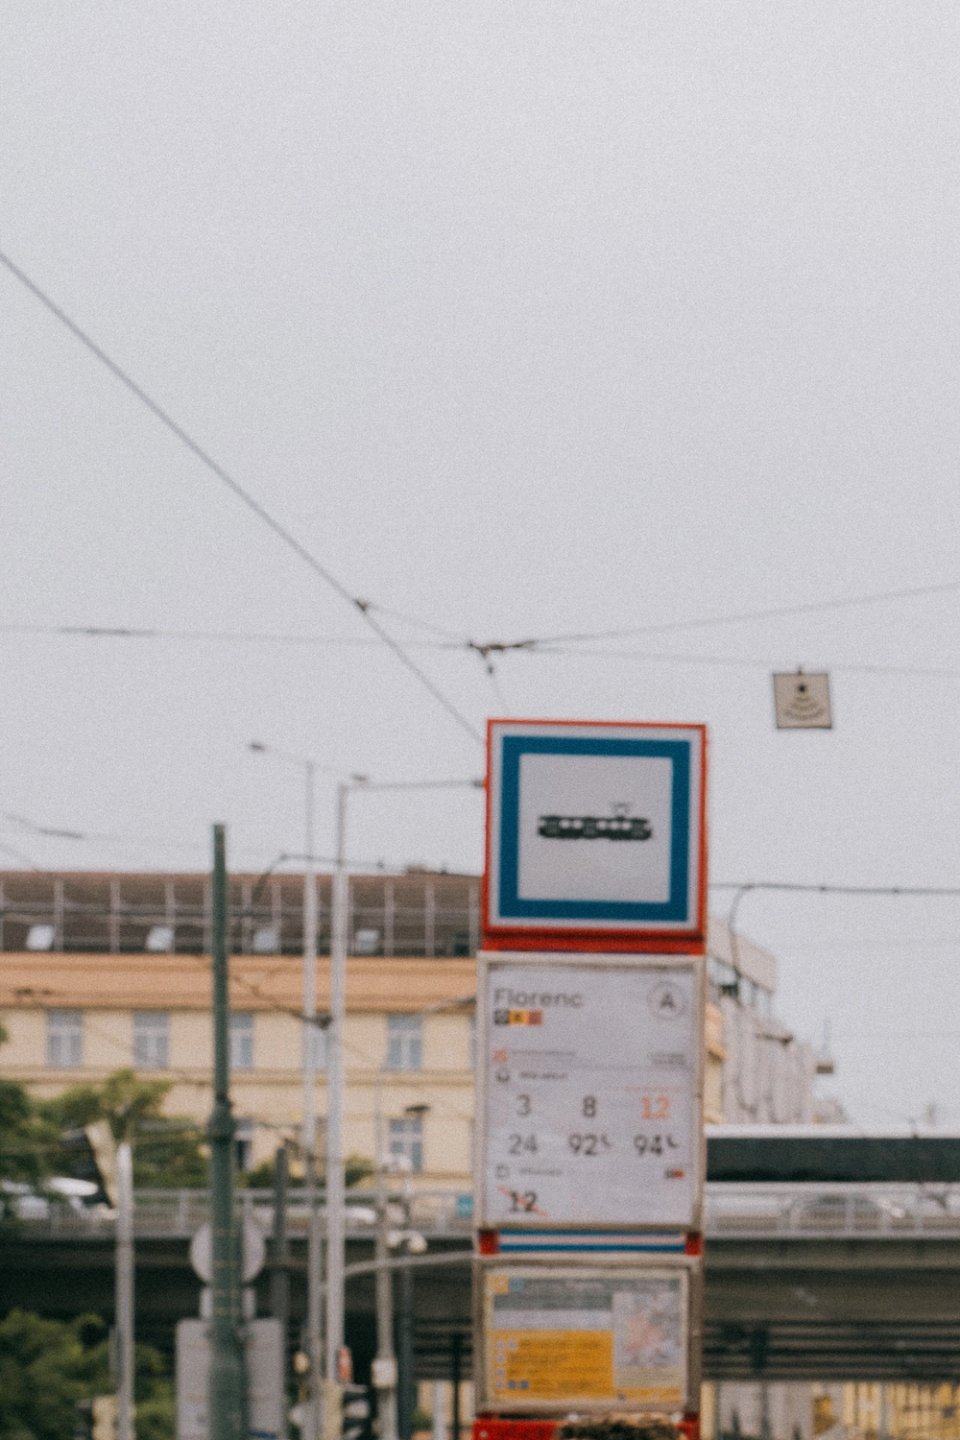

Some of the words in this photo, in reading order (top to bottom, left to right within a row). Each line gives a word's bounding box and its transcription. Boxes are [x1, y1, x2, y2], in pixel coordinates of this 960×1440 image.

[494, 987, 584, 1009] Florenc
[516, 1094, 532, 1117] 3
[582, 1095, 597, 1118] 8
[509, 1134, 538, 1154] 24
[568, 1134, 598, 1156] 92
[634, 1134, 664, 1157] 94
